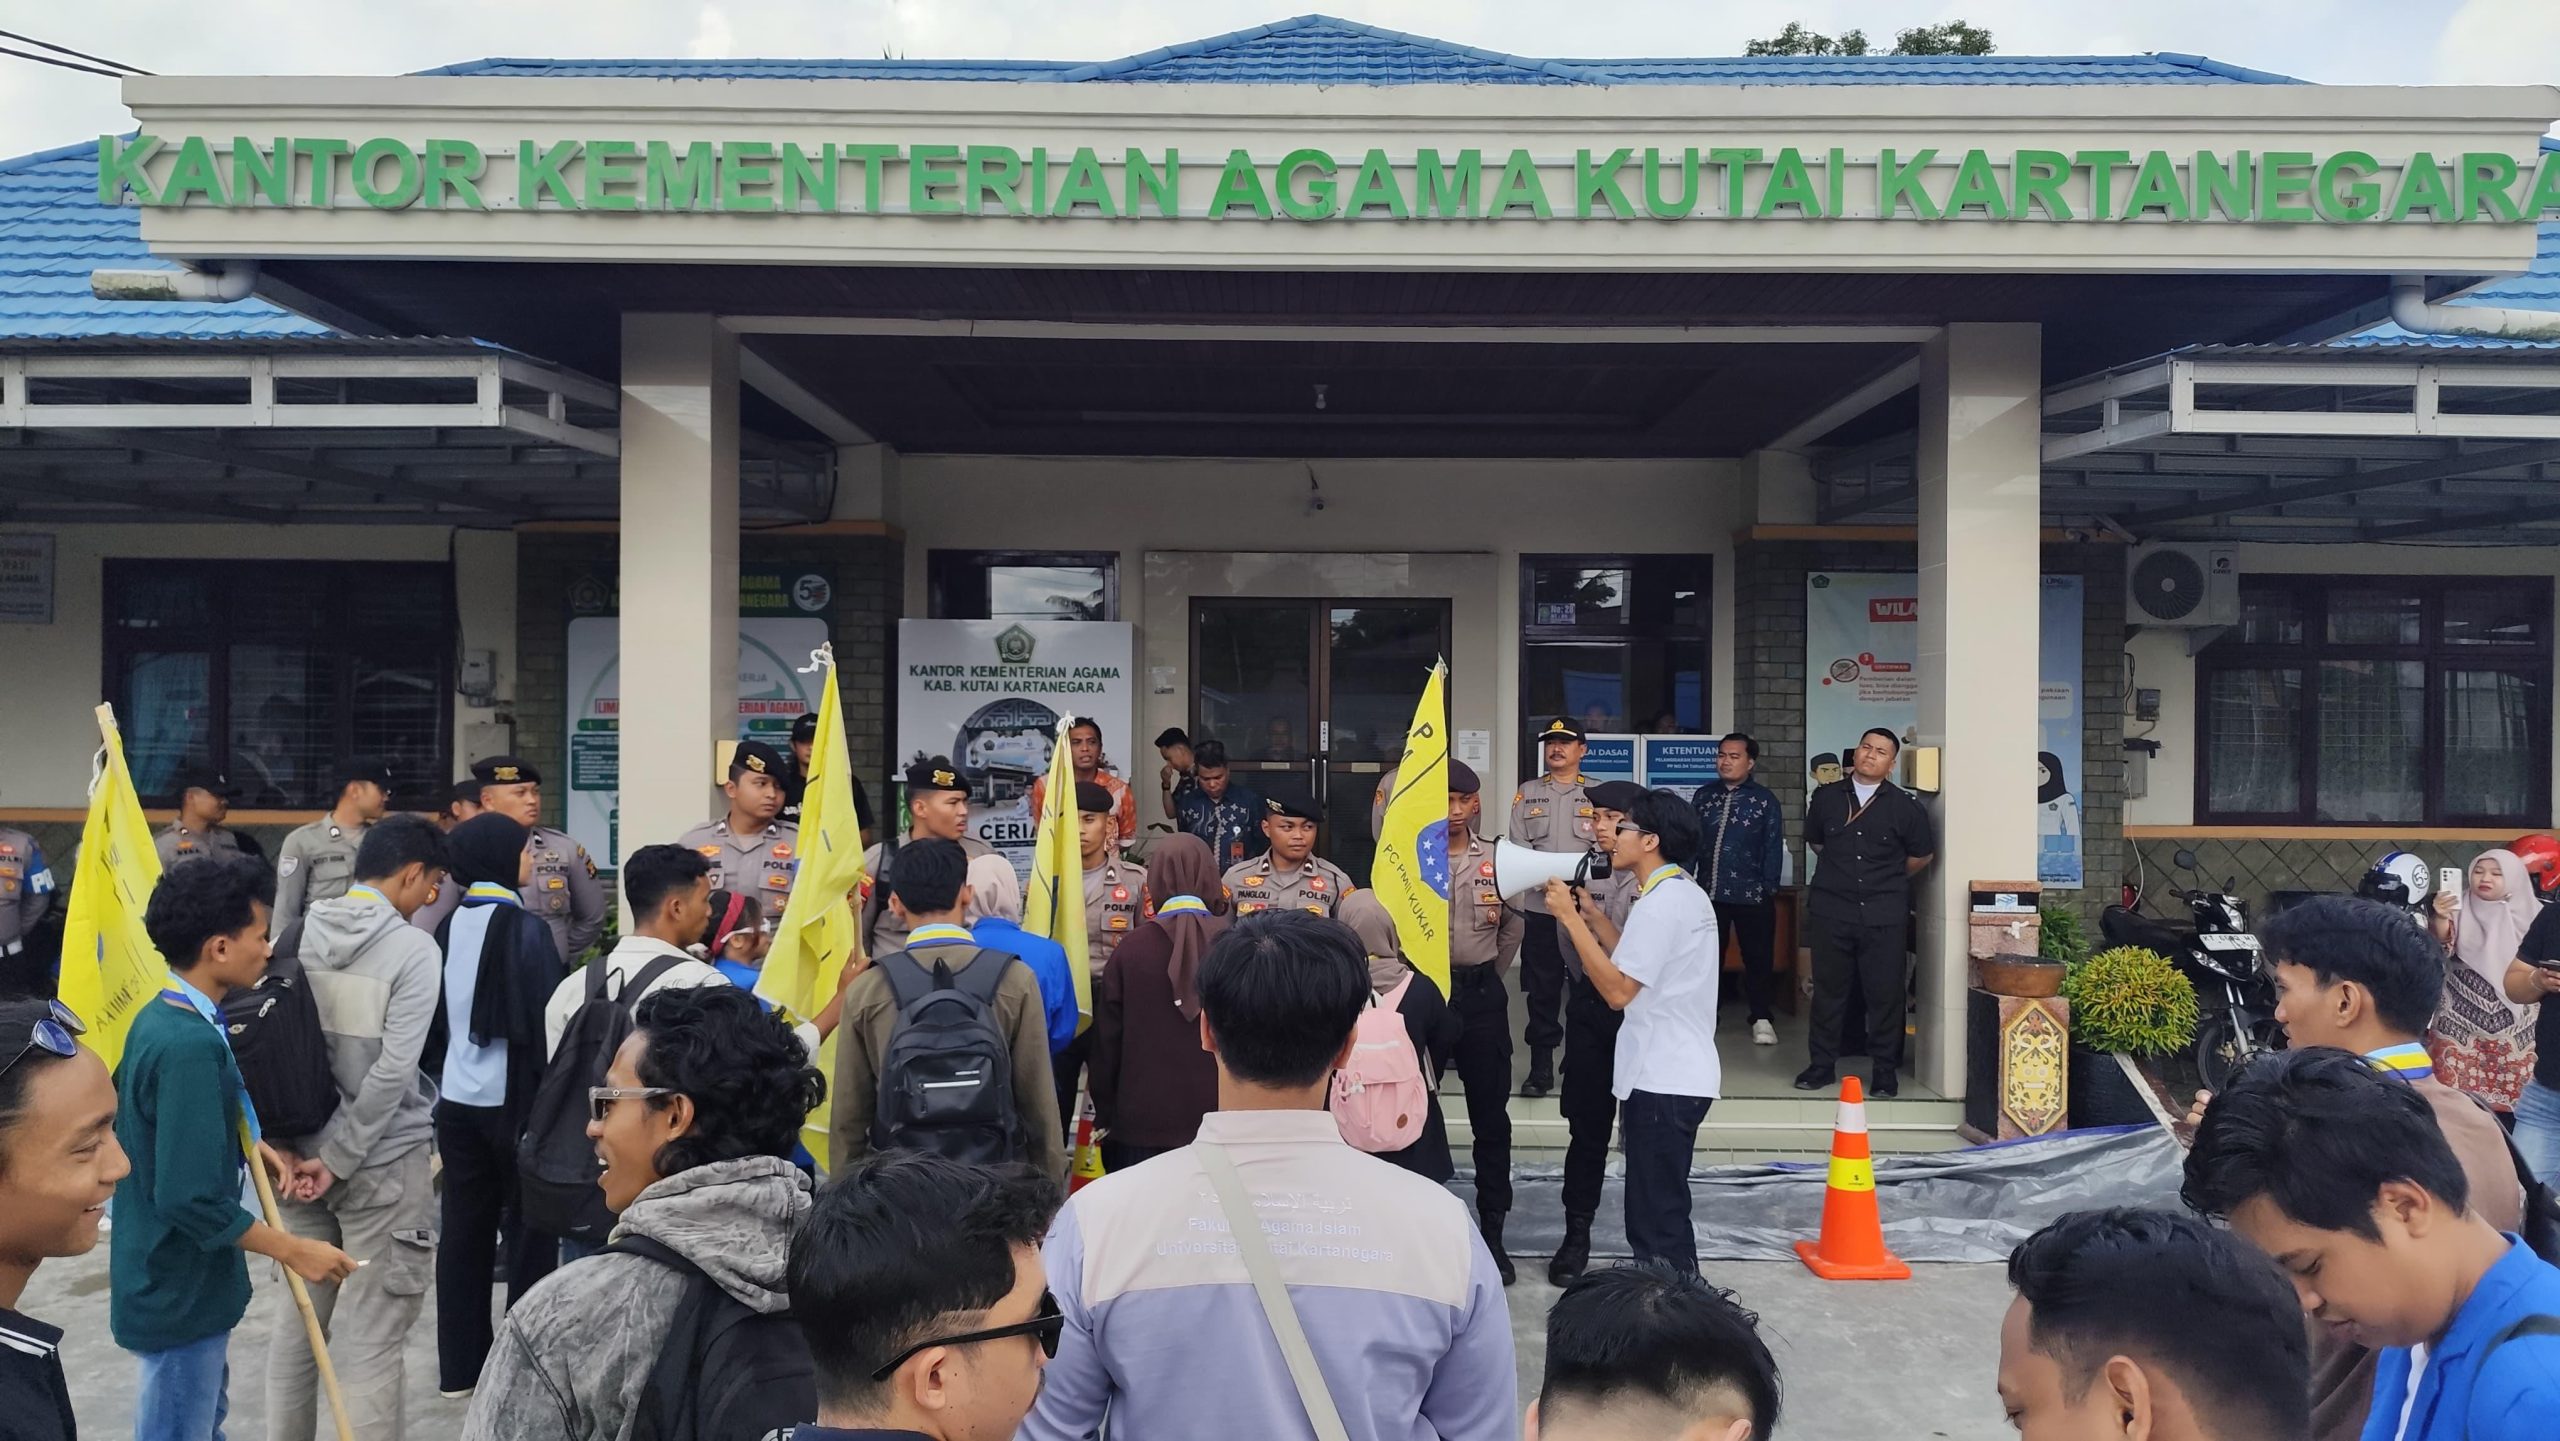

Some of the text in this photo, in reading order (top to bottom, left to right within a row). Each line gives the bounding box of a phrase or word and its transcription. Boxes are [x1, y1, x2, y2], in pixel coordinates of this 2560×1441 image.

[99, 134, 2560, 224] KANTOR KEMENTERIAN AGAMA KUTAI KARTANEGARA
[910, 665, 1120, 679] KANTOR KEMENTERIAN AGAMA
[924, 680, 1105, 693] KAB. KUTAI KARTANEGARA
[770, 702, 805, 714] AGAMA
[1598, 749, 1629, 757] DASAR
[1662, 746, 1719, 756] KETENTUAN
[763, 860, 794, 871] POLR
[1474, 878, 1495, 886] POL
[1299, 889, 1331, 903] POLRI
[1383, 843, 1434, 942] PC PMII KUKAR
[1104, 903, 1136, 912] POLRI
[1187, 1217, 1361, 1237] Fakul Agama Islam
[1156, 1240, 1237, 1257] Universita
[1297, 1242, 1394, 1263] Kartanegara
